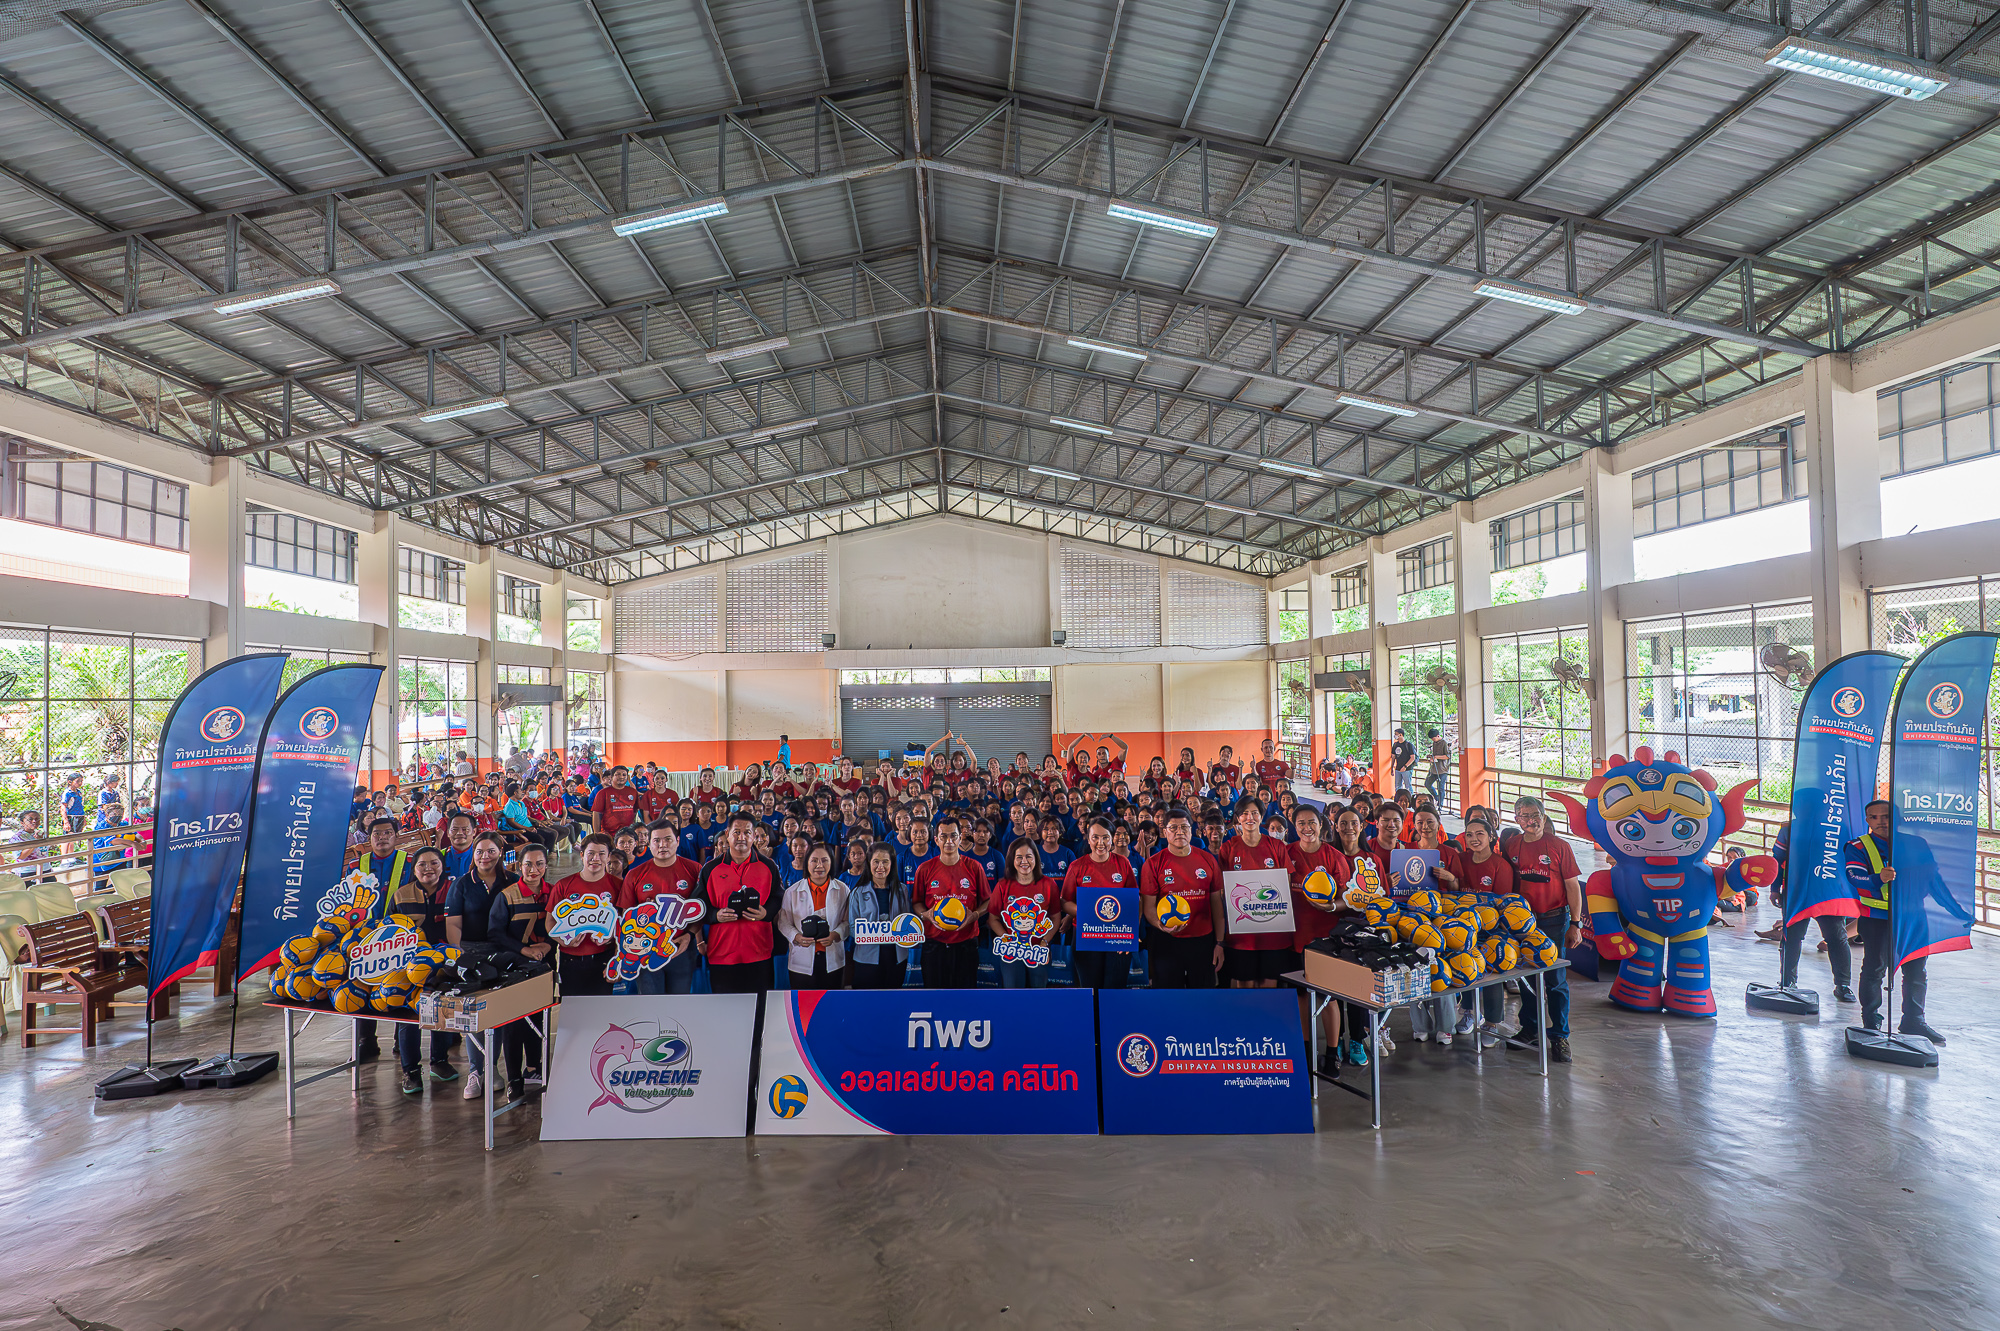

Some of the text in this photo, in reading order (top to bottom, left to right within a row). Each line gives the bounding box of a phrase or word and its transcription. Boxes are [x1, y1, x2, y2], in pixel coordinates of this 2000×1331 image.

[1811, 715, 1874, 736] ทิพยประกันภัย
[1904, 719, 1975, 735] ทิพยประกันภัย
[1839, 730, 1873, 742] INSURANCE
[1937, 735, 1975, 743] INSURANCE
[275, 740, 350, 756] ทิพยประกันภัย
[175, 760, 210, 768] DHIPAYA
[213, 756, 256, 764] INSURANC
[306, 754, 348, 762] INSURANCE
[1902, 789, 1974, 812] โทร.1736
[1814, 754, 1847, 880] ทิพยประกันภัย
[1903, 814, 1973, 826] www.tipinsure.com
[273, 781, 317, 921] ทิพยประกันภัย
[318, 881, 353, 915] OK!
[1351, 893, 1375, 904] GREA
[1653, 899, 1683, 912] TIP
[657, 896, 702, 926] TIP
[1242, 902, 1288, 911] SUPREME
[567, 910, 610, 927] Cool!
[856, 919, 891, 934] ทิพย
[1082, 922, 1133, 933] ทิพยประกันภัย
[351, 932, 417, 959] อยากติด
[856, 933, 924, 943] วอลเลย์บอล คลินิก
[995, 939, 1048, 963] ใจดีจัดให้
[350, 947, 416, 979] ทีมชาติ
[908, 1012, 991, 1048] ทิพย
[1164, 1035, 1287, 1057] ทิพยประกันภัย
[1168, 1062, 1289, 1071] DHIPAYA INSURANCE
[609, 1069, 702, 1086] SUPREME
[840, 1061, 1079, 1092] วอลเลย์บอล คลินิก
